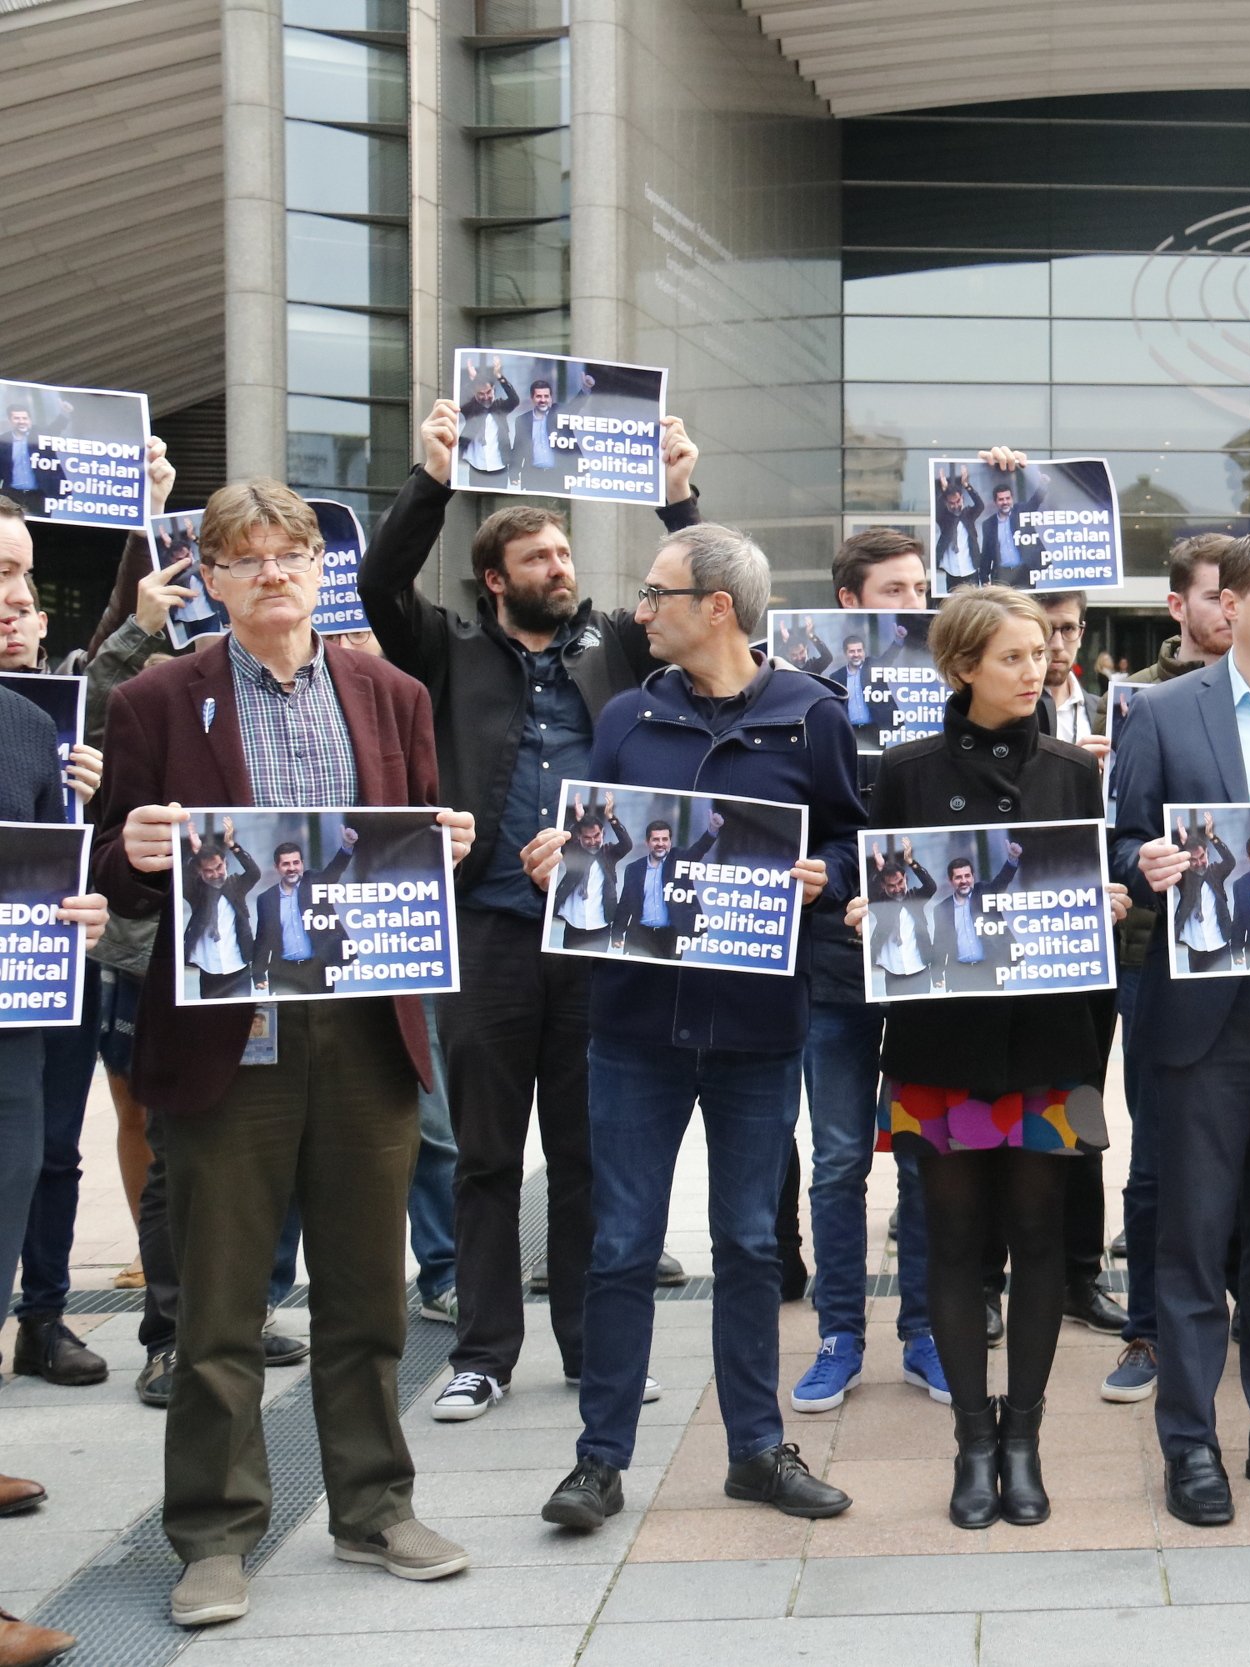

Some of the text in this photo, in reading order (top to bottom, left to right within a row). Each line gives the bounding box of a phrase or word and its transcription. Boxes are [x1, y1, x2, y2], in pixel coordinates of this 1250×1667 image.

[557, 414, 654, 437] FREEDOM
[38, 435, 139, 460] FREEDOM
[549, 432, 653, 456] for Catalan
[30, 453, 139, 478] for Catalan
[578, 456, 653, 474] political
[60, 478, 138, 498] political
[565, 473, 653, 493] prisoners
[45, 496, 138, 517] prisoners
[1020, 511, 1108, 526] FREEDOM
[1013, 528, 1109, 545] for Catalan
[1041, 545, 1111, 565] political
[322, 571, 357, 587] alan
[1030, 565, 1112, 584] prisoners
[311, 609, 363, 624] oners
[871, 668, 944, 682] FREED
[863, 686, 892, 702] for
[893, 706, 942, 725] politi
[675, 859, 791, 889] FREEDOM
[312, 881, 438, 904] FREEDOM
[664, 882, 787, 911] for Catalan
[982, 888, 1096, 912] FREEDOM
[302, 907, 440, 930] for Catalan
[694, 911, 785, 935] political
[974, 912, 1098, 935] for Catalan
[0, 931, 69, 953] atalan
[342, 930, 441, 959] political
[676, 933, 782, 959] prisoners
[1011, 933, 1099, 961] political
[0, 958, 68, 980] litical
[326, 959, 443, 986] prisoners
[996, 960, 1101, 985] prisoners
[0, 992, 66, 1009] oners
